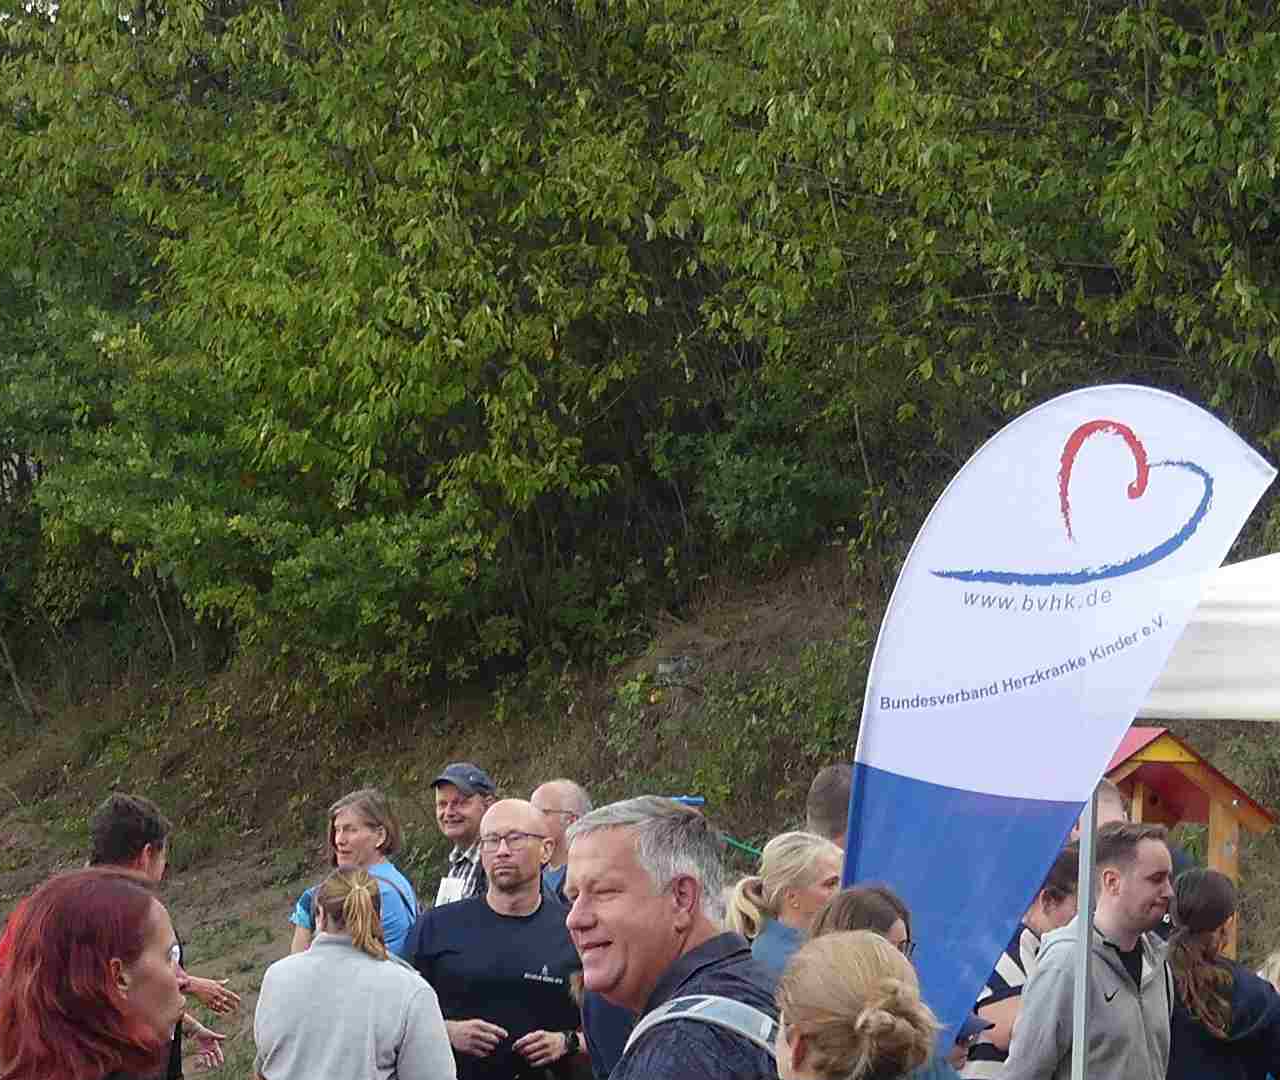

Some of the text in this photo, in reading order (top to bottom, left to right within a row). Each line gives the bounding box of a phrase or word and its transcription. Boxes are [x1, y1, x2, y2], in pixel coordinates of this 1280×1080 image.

[961, 589, 1113, 612] www.bvhk.de
[880, 614, 1169, 710] Bundesverband Herzkranke Kinder e.V.
